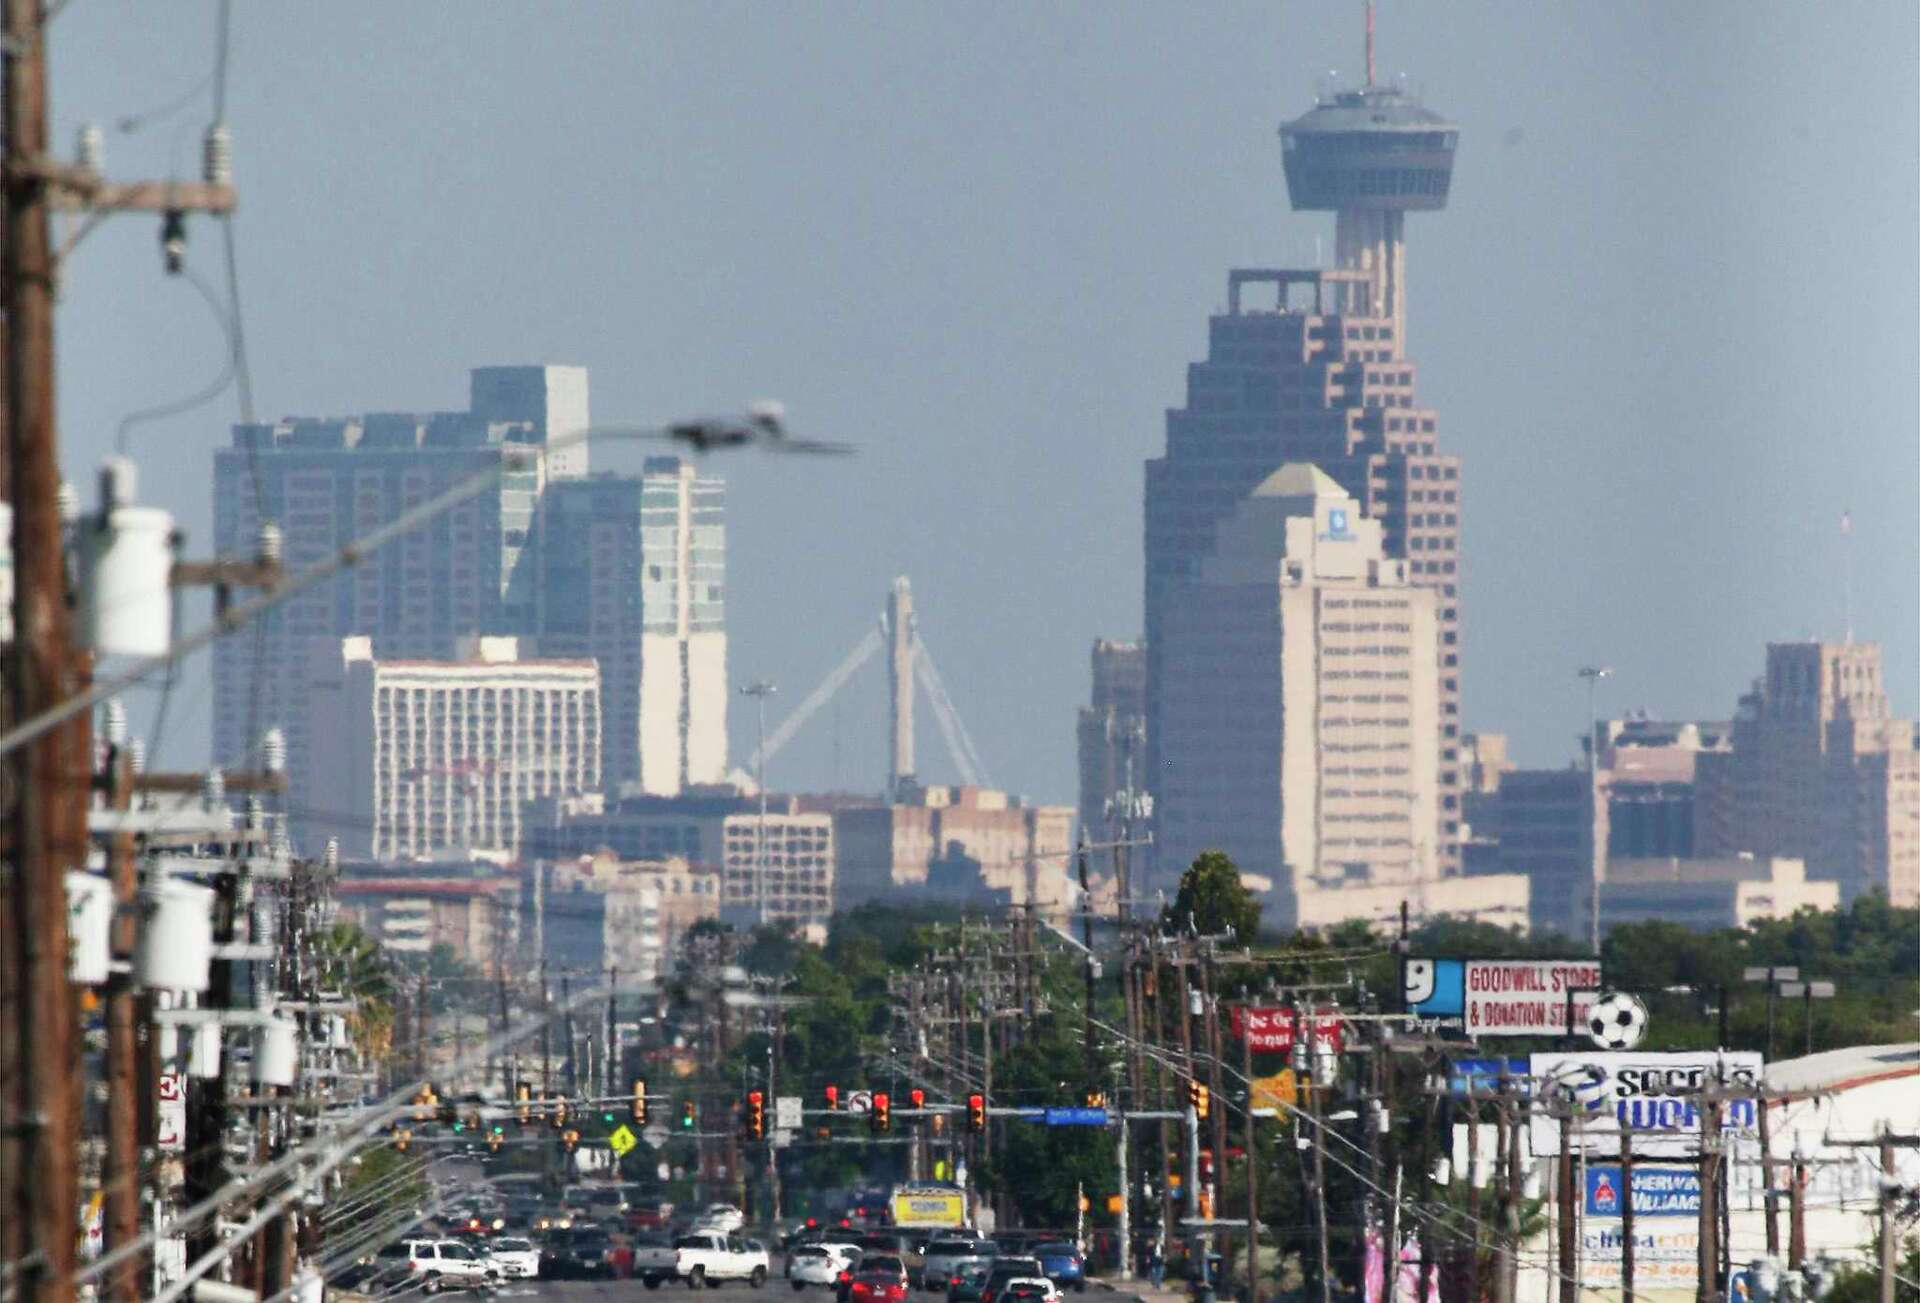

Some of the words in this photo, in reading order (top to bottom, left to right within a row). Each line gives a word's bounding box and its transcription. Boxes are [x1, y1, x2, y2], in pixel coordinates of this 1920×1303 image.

[1470, 967, 1546, 991] GOODWILL
[1551, 966, 1600, 992] STORE
[1470, 1001, 1479, 1026] &
[1484, 1001, 1545, 1027] DONATION
[1616, 1069, 1754, 1096] SOCC
[1632, 1175, 1701, 1190] HERWIN
